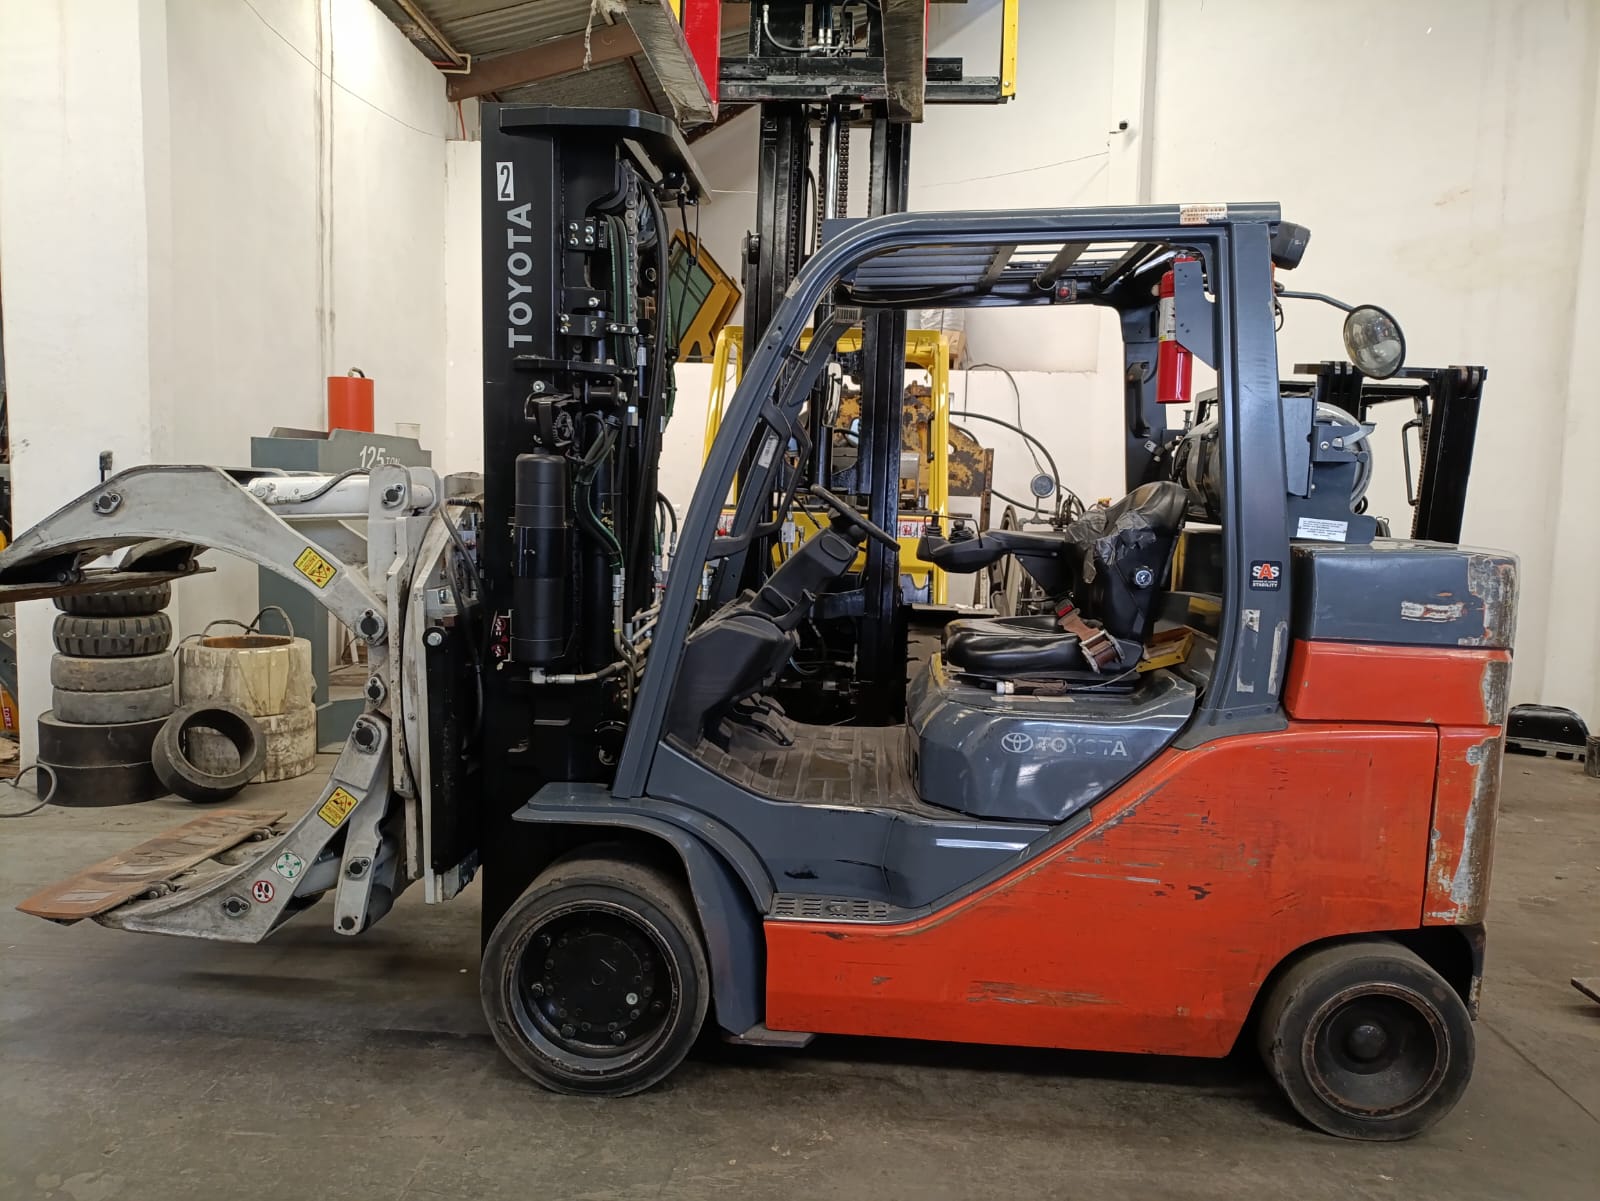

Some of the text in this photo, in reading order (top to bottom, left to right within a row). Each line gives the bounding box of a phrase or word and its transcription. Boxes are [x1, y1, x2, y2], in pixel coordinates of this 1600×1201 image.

[498, 163, 512, 200] 2
[506, 201, 533, 349] TOYOTA
[359, 445, 386, 470] 125
[1252, 563, 1280, 580] SAS
